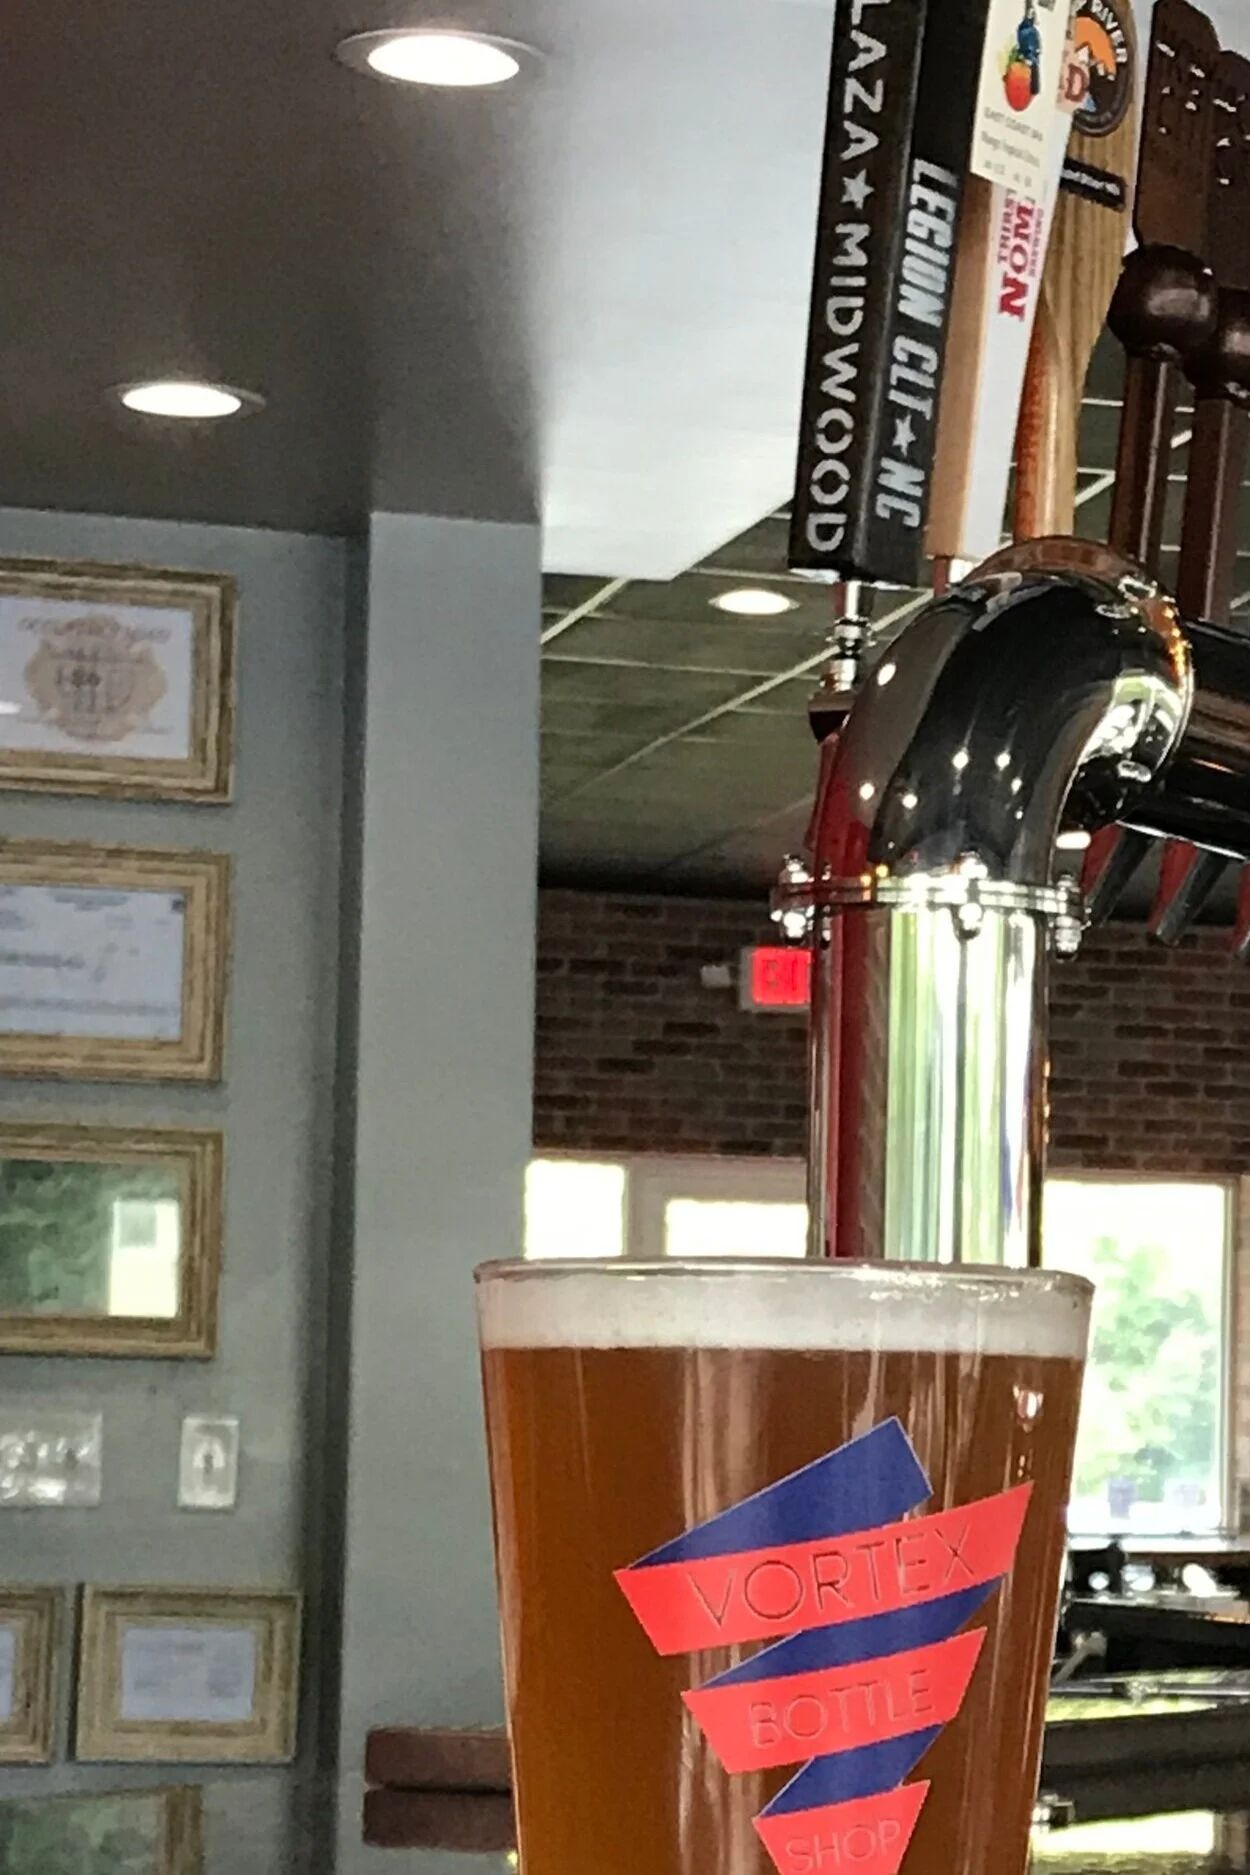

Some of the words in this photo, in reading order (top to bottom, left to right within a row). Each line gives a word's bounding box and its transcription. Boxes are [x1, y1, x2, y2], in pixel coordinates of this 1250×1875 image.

[840, 0, 891, 161] LAZA
[897, 157, 960, 328] LEGION
[997, 188, 1017, 265] THIRST
[998, 197, 1035, 322] NOM
[804, 222, 872, 553] MIDWOOD
[887, 333, 941, 421] CLT
[875, 455, 926, 529] NC
[688, 1526, 976, 1628] VORTEX
[750, 1669, 934, 1750] BOTTLE
[784, 1820, 902, 1875] SHOP
